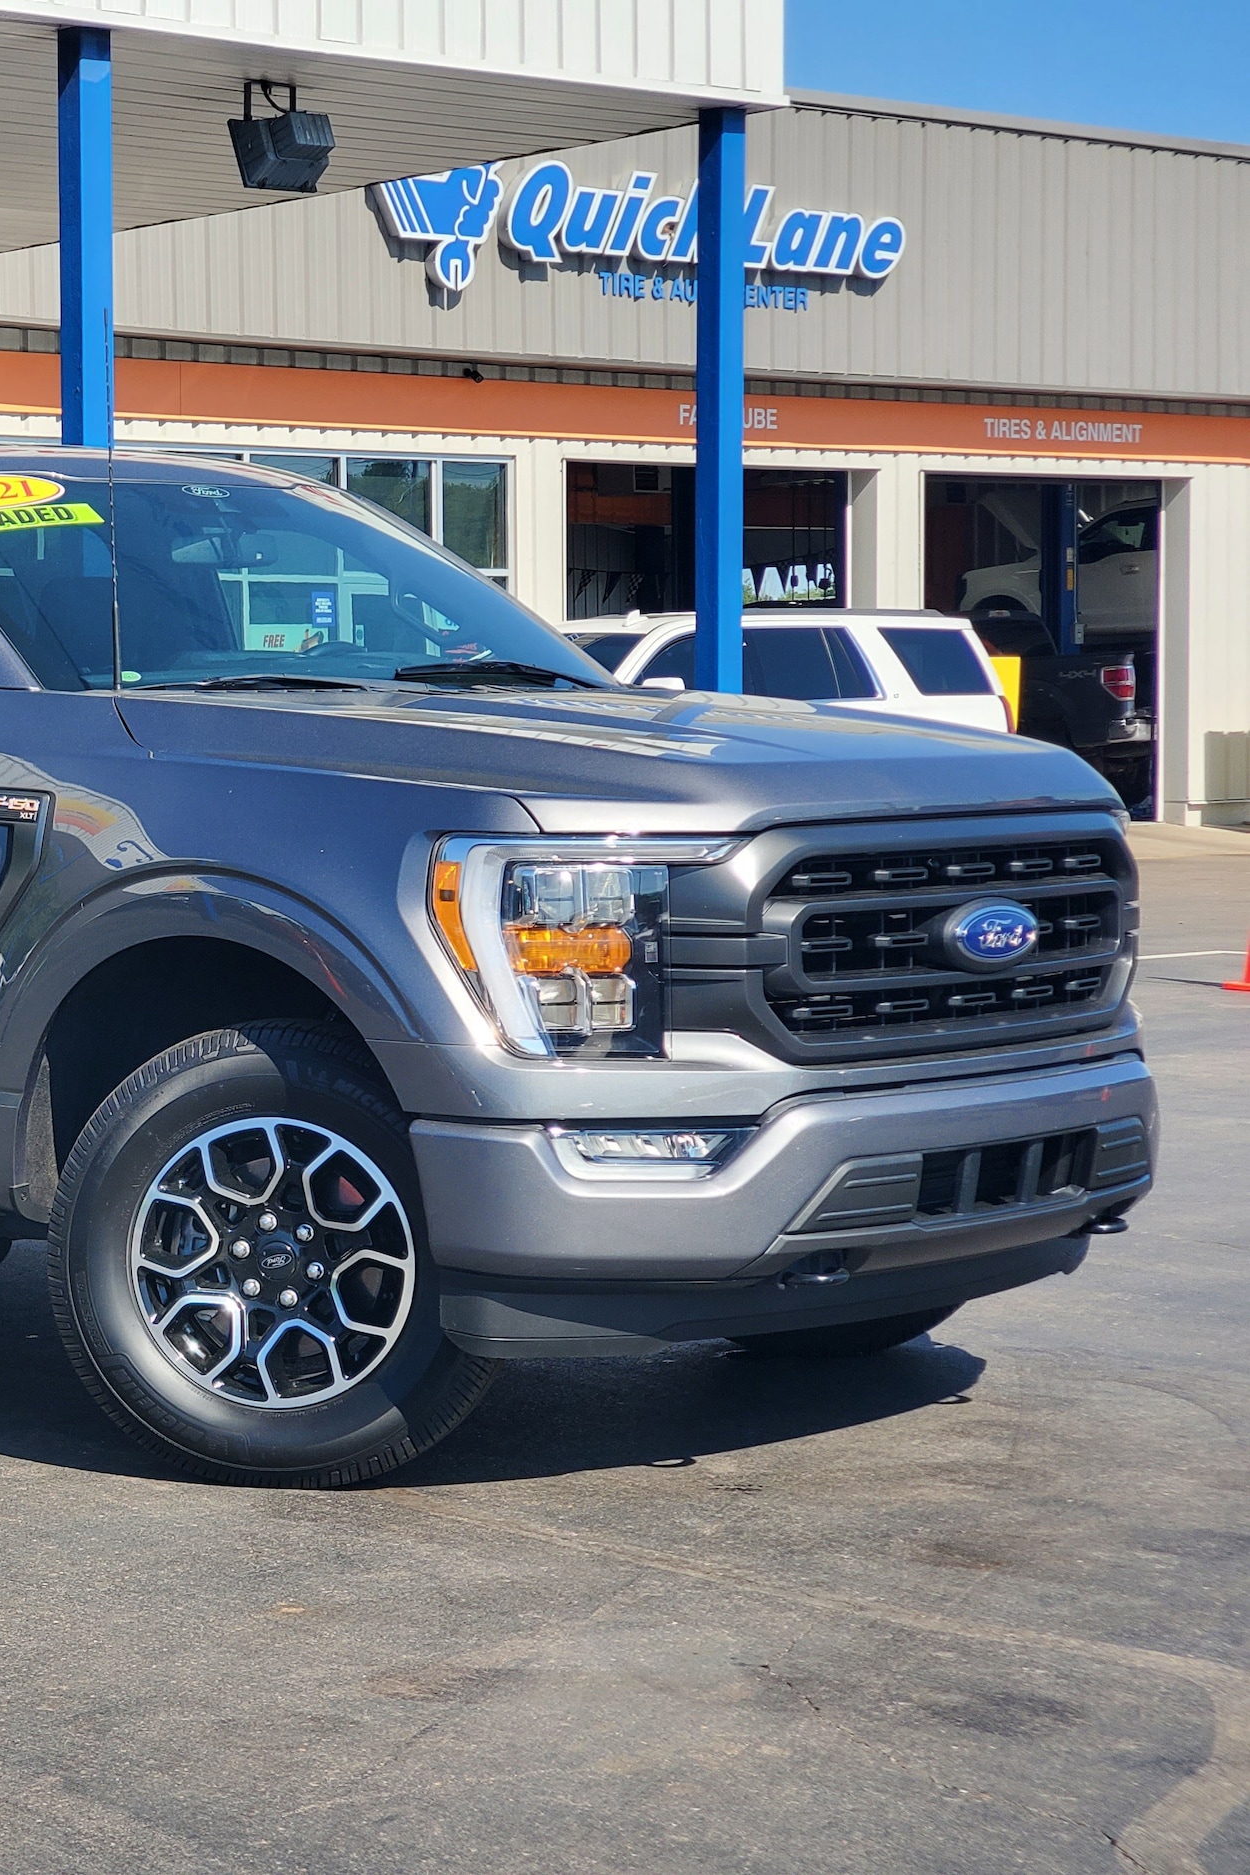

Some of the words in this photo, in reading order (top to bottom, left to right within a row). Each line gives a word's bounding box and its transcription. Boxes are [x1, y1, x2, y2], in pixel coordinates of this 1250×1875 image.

[744, 183, 906, 280] Lane
[599, 271, 646, 299] TIRE
[652, 277, 665, 300] &
[670, 280, 698, 303] AU
[745, 284, 808, 311] ENTER
[679, 404, 697, 425] FA
[743, 408, 778, 429] UBE
[984, 418, 1031, 440] TIRES
[1035, 420, 1047, 440] &
[1051, 421, 1143, 443] ALIGNMENT
[263, 634, 286, 648] FREE
[19, 811, 35, 820] XLT
[978, 918, 1023, 949] Ford
